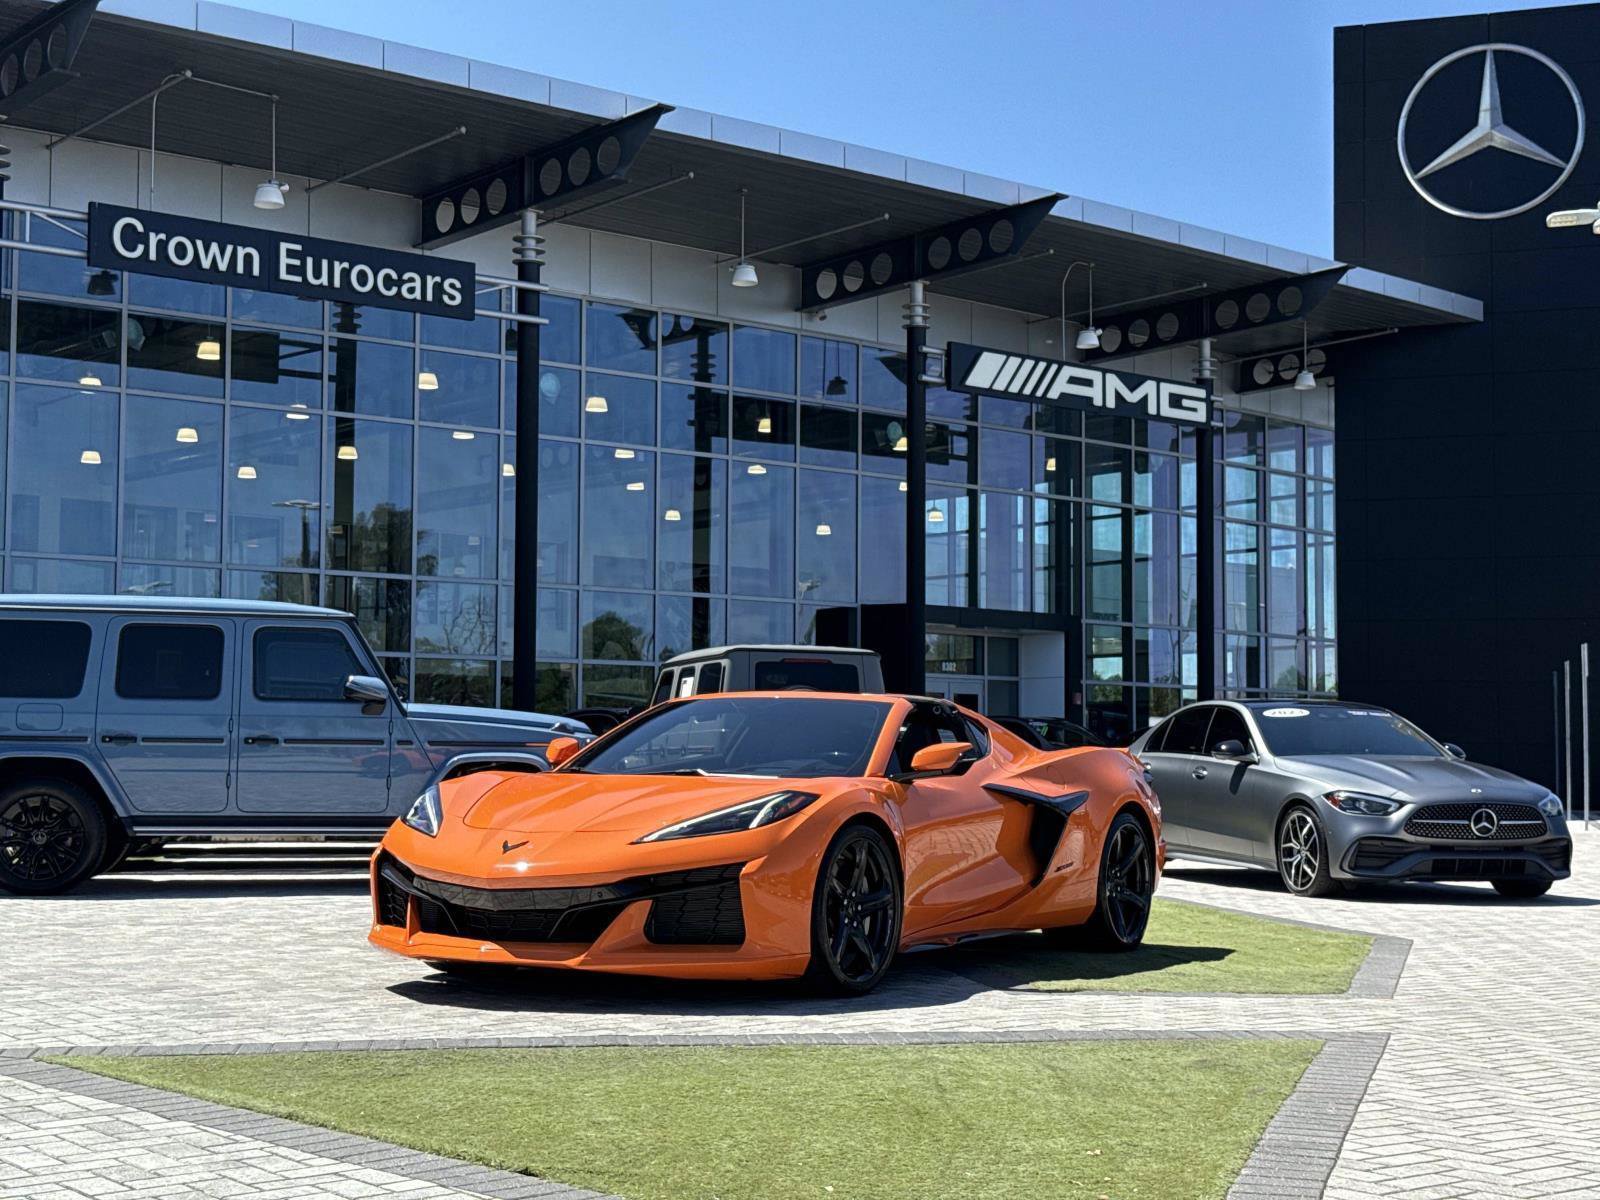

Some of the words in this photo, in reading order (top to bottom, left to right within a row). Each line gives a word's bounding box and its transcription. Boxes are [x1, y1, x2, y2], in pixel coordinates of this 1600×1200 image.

[112, 216, 260, 277] Crown
[278, 242, 463, 306] Eurocars
[1046, 364, 1207, 423] AMG
